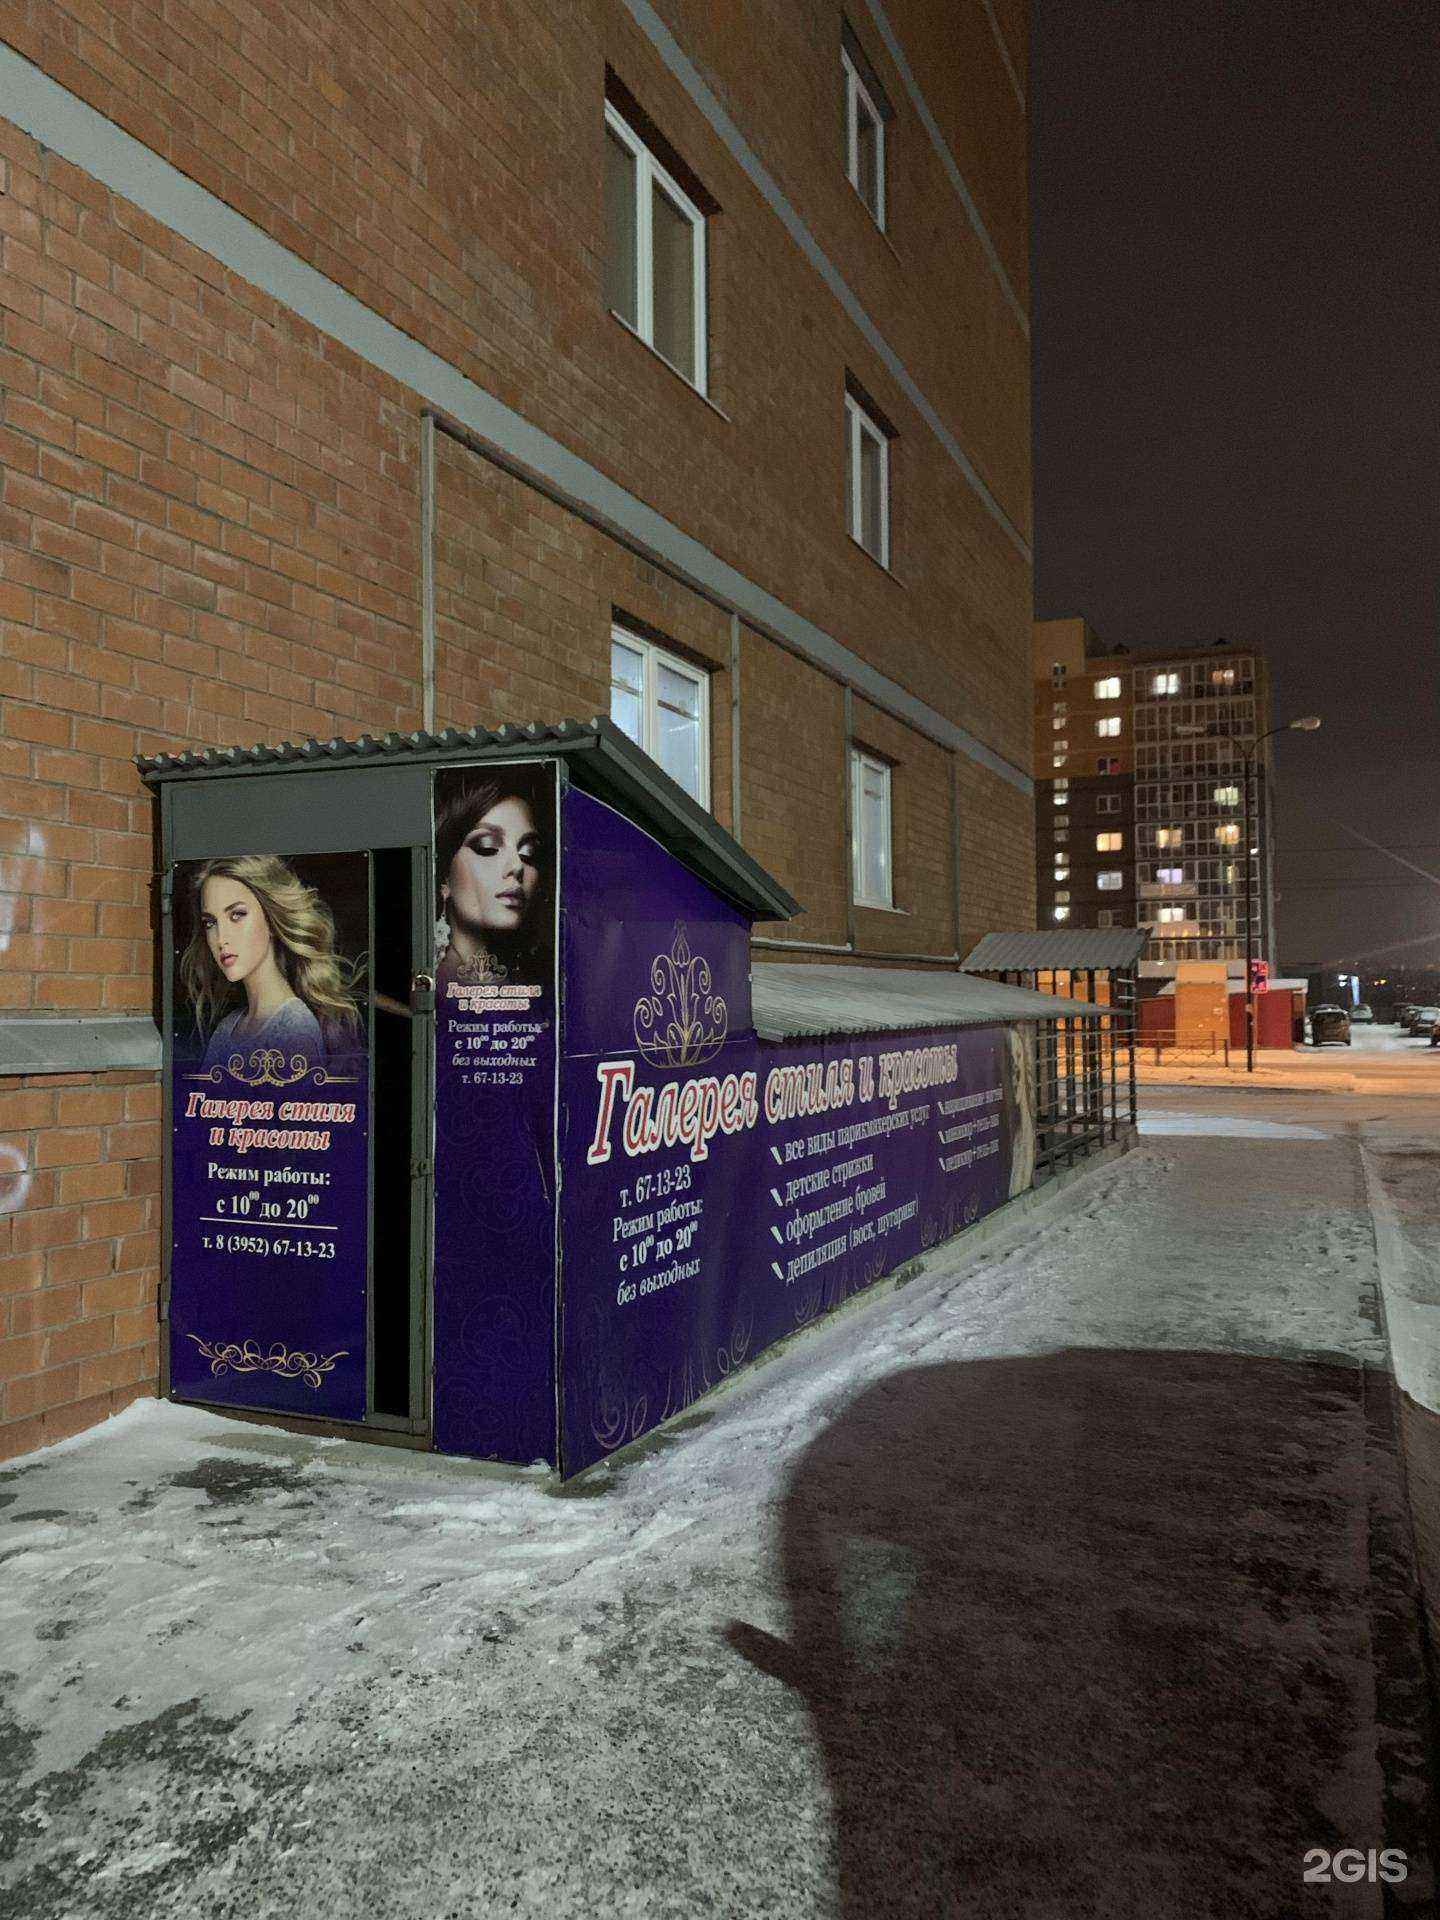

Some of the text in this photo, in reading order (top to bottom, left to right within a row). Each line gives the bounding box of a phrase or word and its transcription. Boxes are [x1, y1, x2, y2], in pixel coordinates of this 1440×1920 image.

[448, 1020, 489, 1033] Режим
[452, 1053, 537, 1067] без выходных
[455, 1041, 463, 1049] с
[490, 1040, 508, 1051] до
[473, 1072, 524, 1085] 67-13-23
[185, 1092, 356, 1125] Галерея стиля
[587, 1060, 758, 1165] Галерея
[765, 1056, 854, 1124] стиля
[858, 1056, 874, 1102] и
[878, 1044, 959, 1110] красоты
[208, 1127, 331, 1153] и красоты
[784, 1139, 806, 1162] все
[807, 1130, 836, 1156] виды
[207, 1162, 331, 1186] Режим работы:
[620, 1164, 692, 1208] т. 67-13-23
[785, 1153, 875, 1208] детские стрижки
[216, 1199, 226, 1213] с
[259, 1203, 281, 1218] до
[786, 1176, 887, 1245] оформление бровей
[612, 1214, 654, 1242] Режим
[202, 1236, 336, 1258] т. 8 (3952) 67-13-23
[619, 1254, 628, 1272] с
[655, 1238, 673, 1262] до
[785, 1234, 848, 1287] депиляция
[616, 1258, 701, 1306] без выходных
